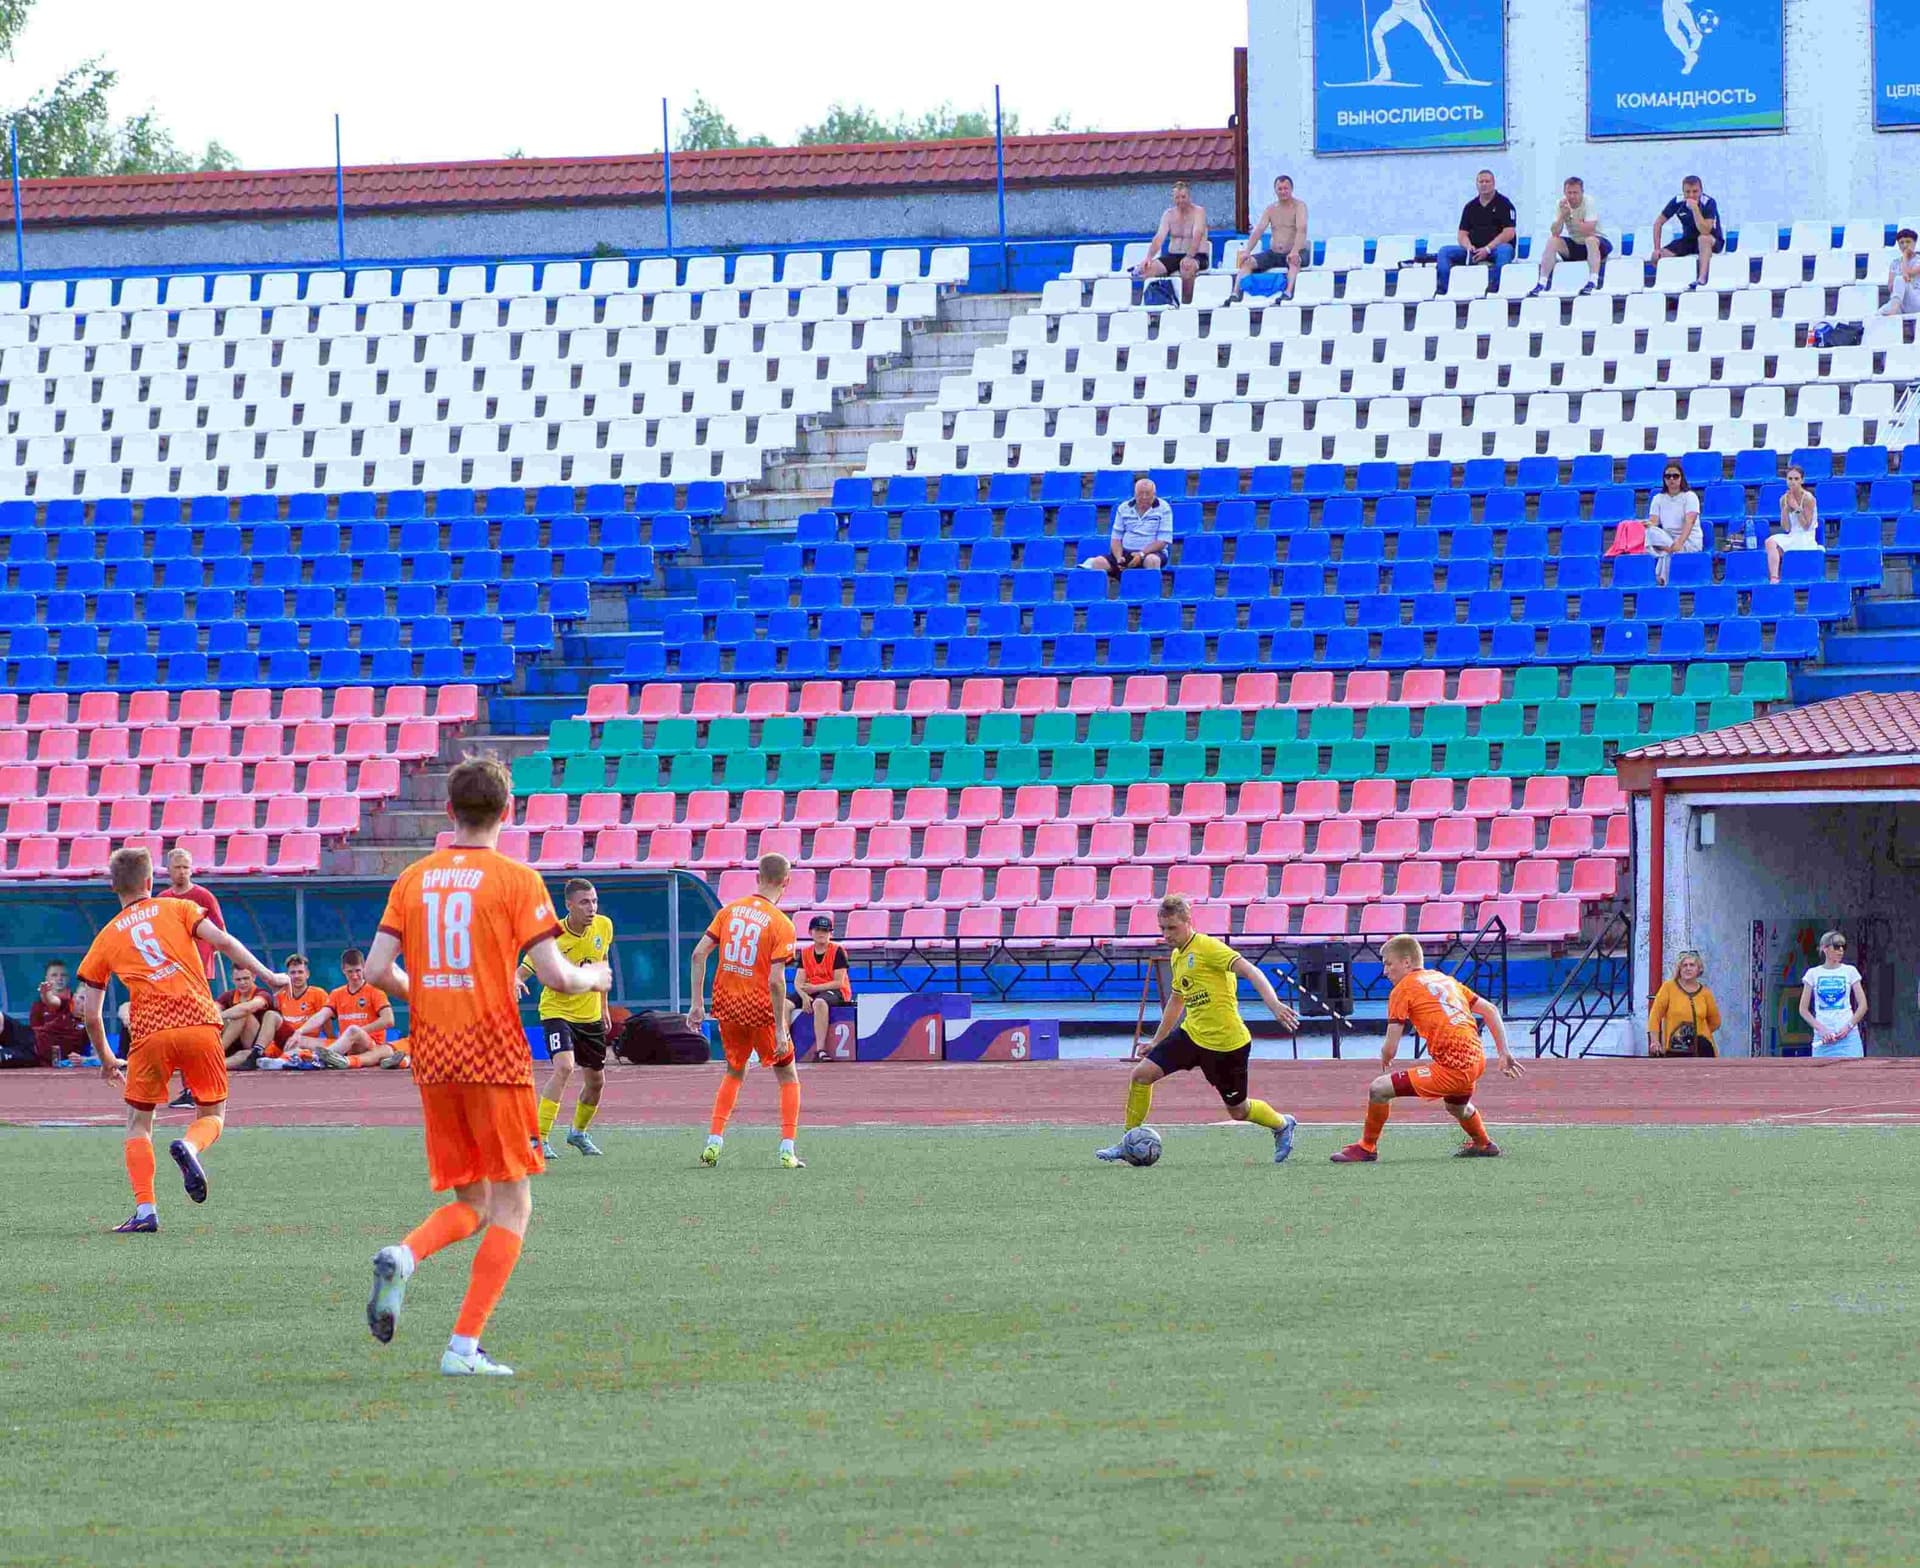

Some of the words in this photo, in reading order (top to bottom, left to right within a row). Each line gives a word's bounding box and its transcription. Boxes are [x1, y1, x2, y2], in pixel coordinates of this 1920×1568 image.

[1336, 105, 1484, 126] ВЫНОСЛИВОСТЬ
[1616, 88, 1757, 109] КОМАНДНОСТЬ
[131, 921, 166, 968] 6
[422, 891, 472, 970] 18
[724, 917, 762, 967] 33
[549, 1032, 561, 1052] 18
[835, 1023, 850, 1057] 2
[926, 1019, 936, 1055] 1
[1010, 1031, 1026, 1059] 3
